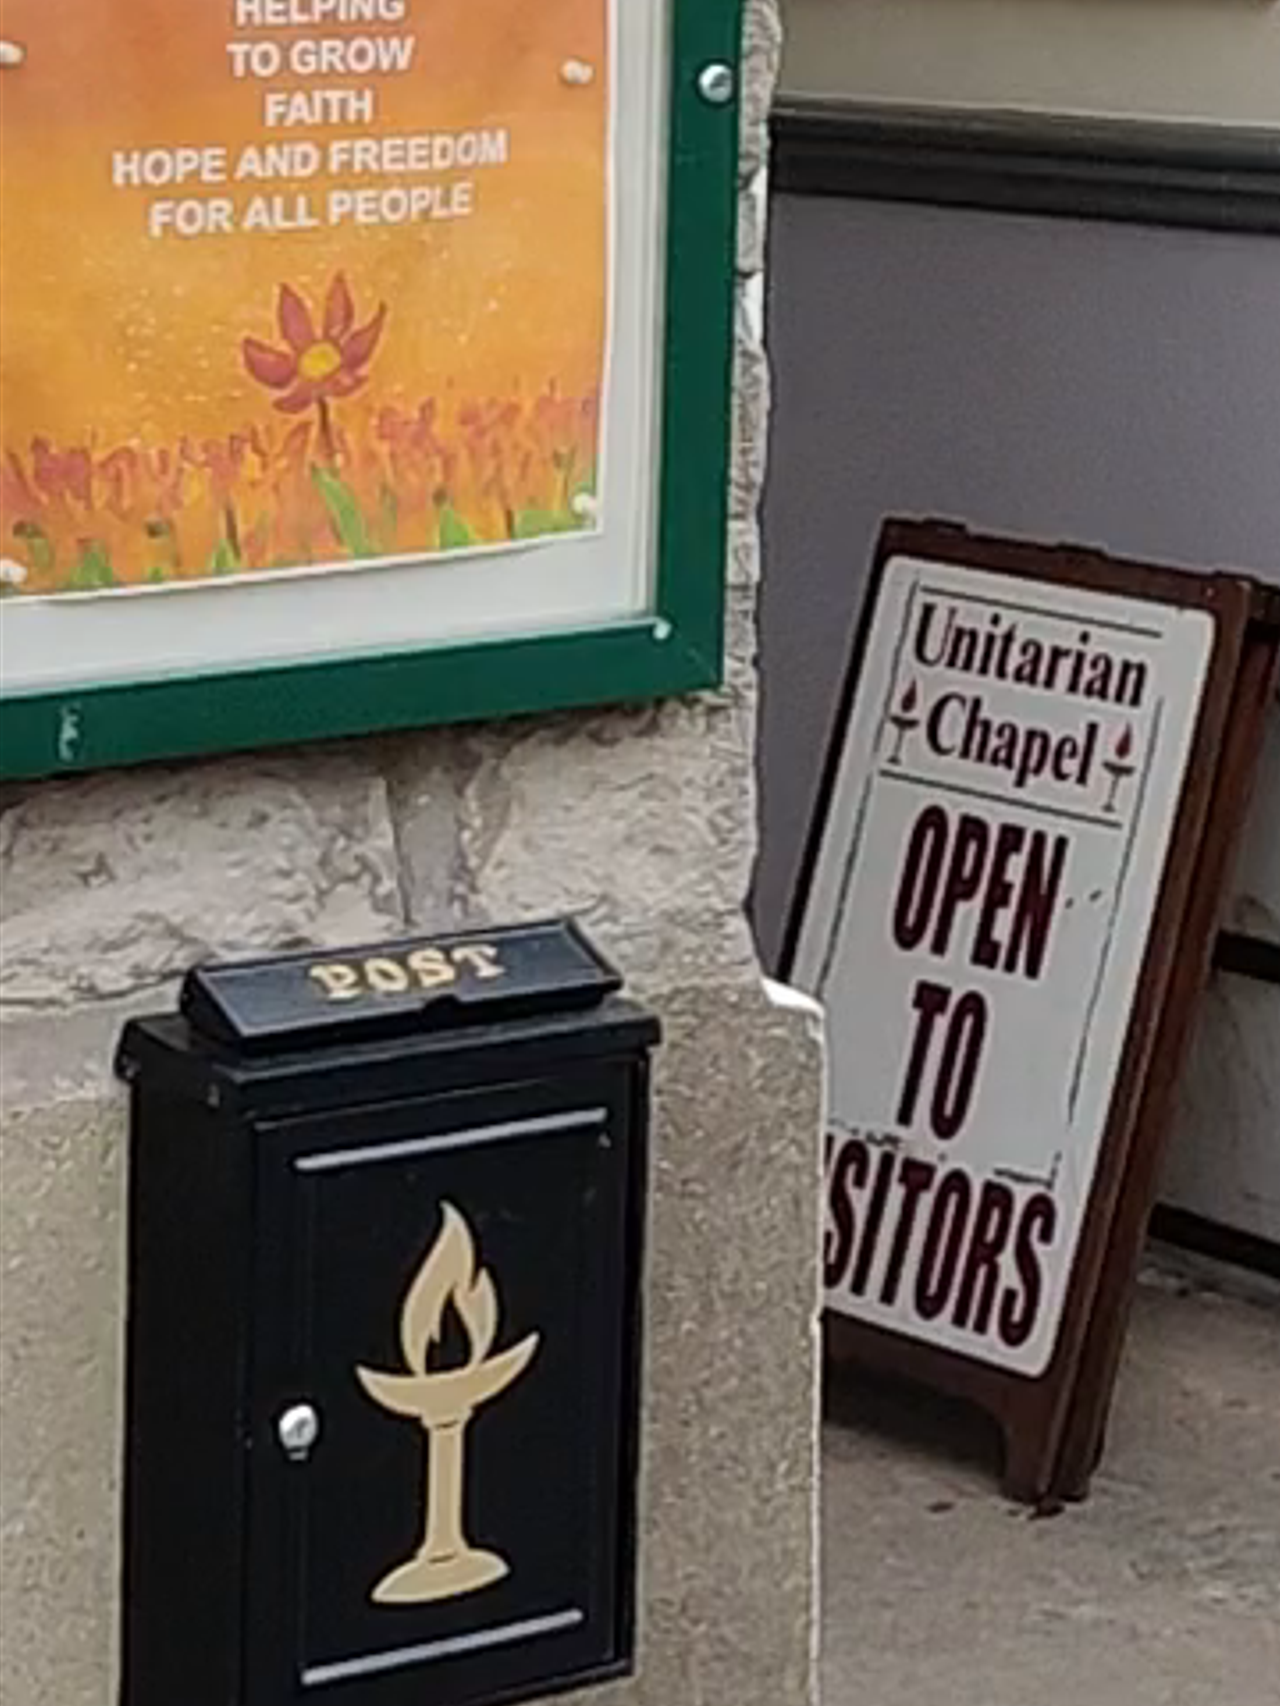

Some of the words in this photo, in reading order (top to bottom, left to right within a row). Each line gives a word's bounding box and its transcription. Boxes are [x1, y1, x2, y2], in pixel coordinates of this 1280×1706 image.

[227, 41, 278, 77] TO
[289, 35, 415, 76] GROW
[263, 88, 374, 128] FAITH
[112, 147, 227, 188] HOPE
[234, 141, 320, 181] AND
[329, 130, 509, 173] FREEDOM
[148, 197, 233, 238] FOR
[243, 194, 319, 232] ALL
[328, 182, 474, 226] PEOPLE
[914, 601, 1148, 708] Unitarian
[926, 692, 1100, 788] Chapel
[893, 803, 1068, 981] OPEN
[309, 943, 505, 999] POST
[897, 981, 986, 1142] TO
[824, 1134, 1057, 1347] SITORS
